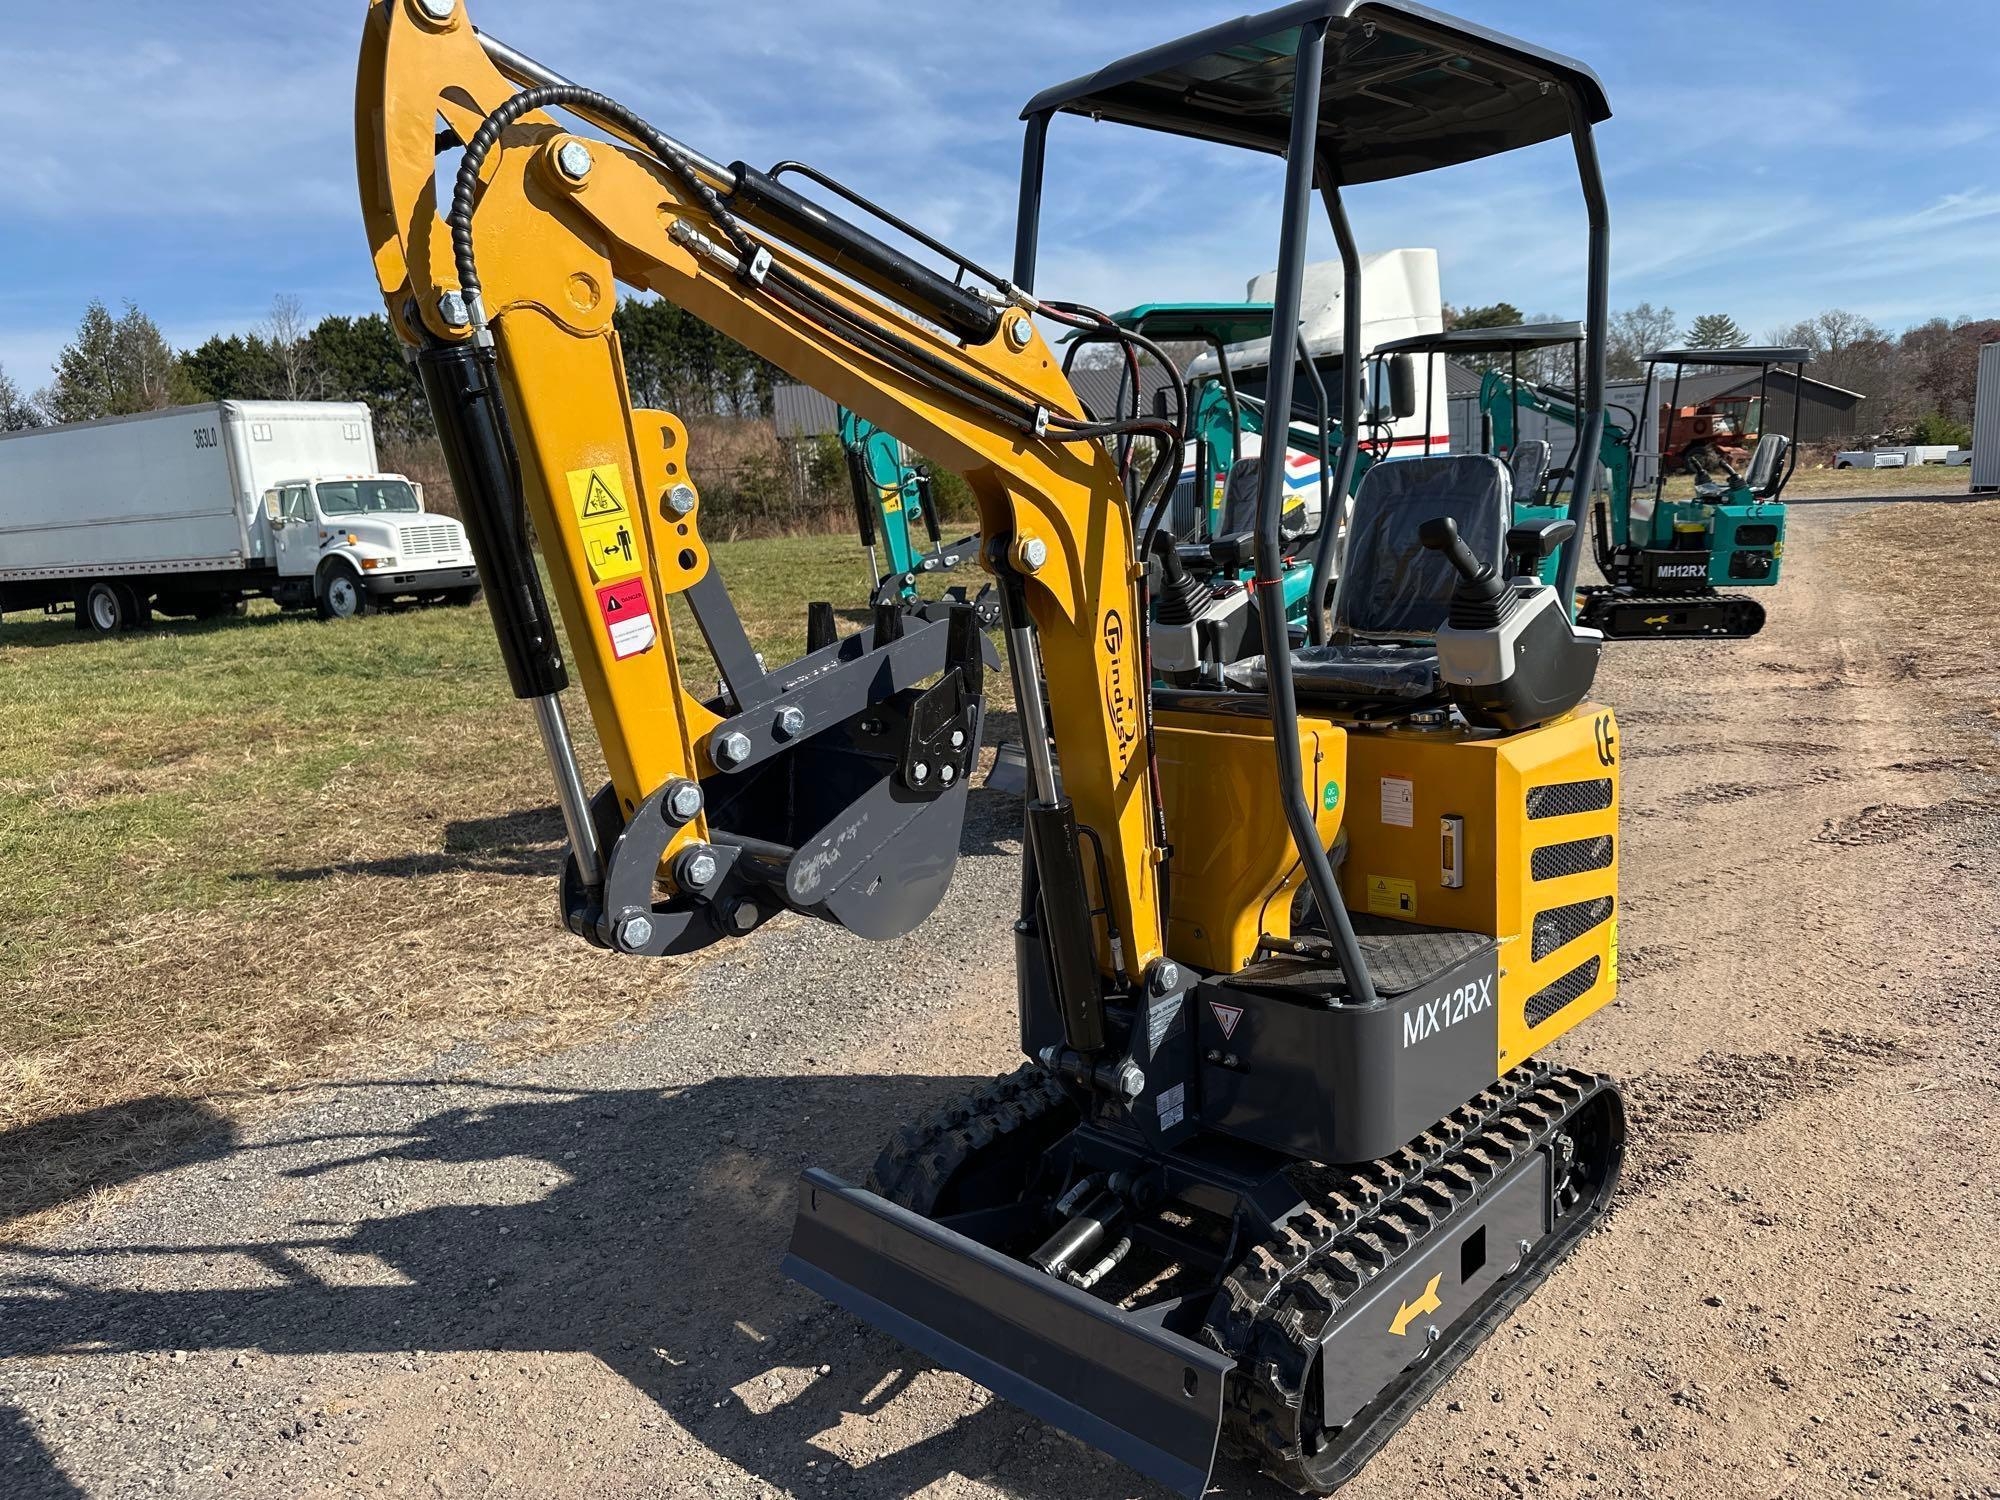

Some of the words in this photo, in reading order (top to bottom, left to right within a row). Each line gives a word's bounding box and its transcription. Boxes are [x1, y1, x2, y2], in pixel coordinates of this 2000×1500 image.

[1745, 506, 1764, 520] CE
[1657, 565, 1707, 577] MH12RX
[621, 592, 642, 602] DANGER
[1595, 714, 1615, 767] CE
[1403, 973, 1493, 1049] MX12RX
